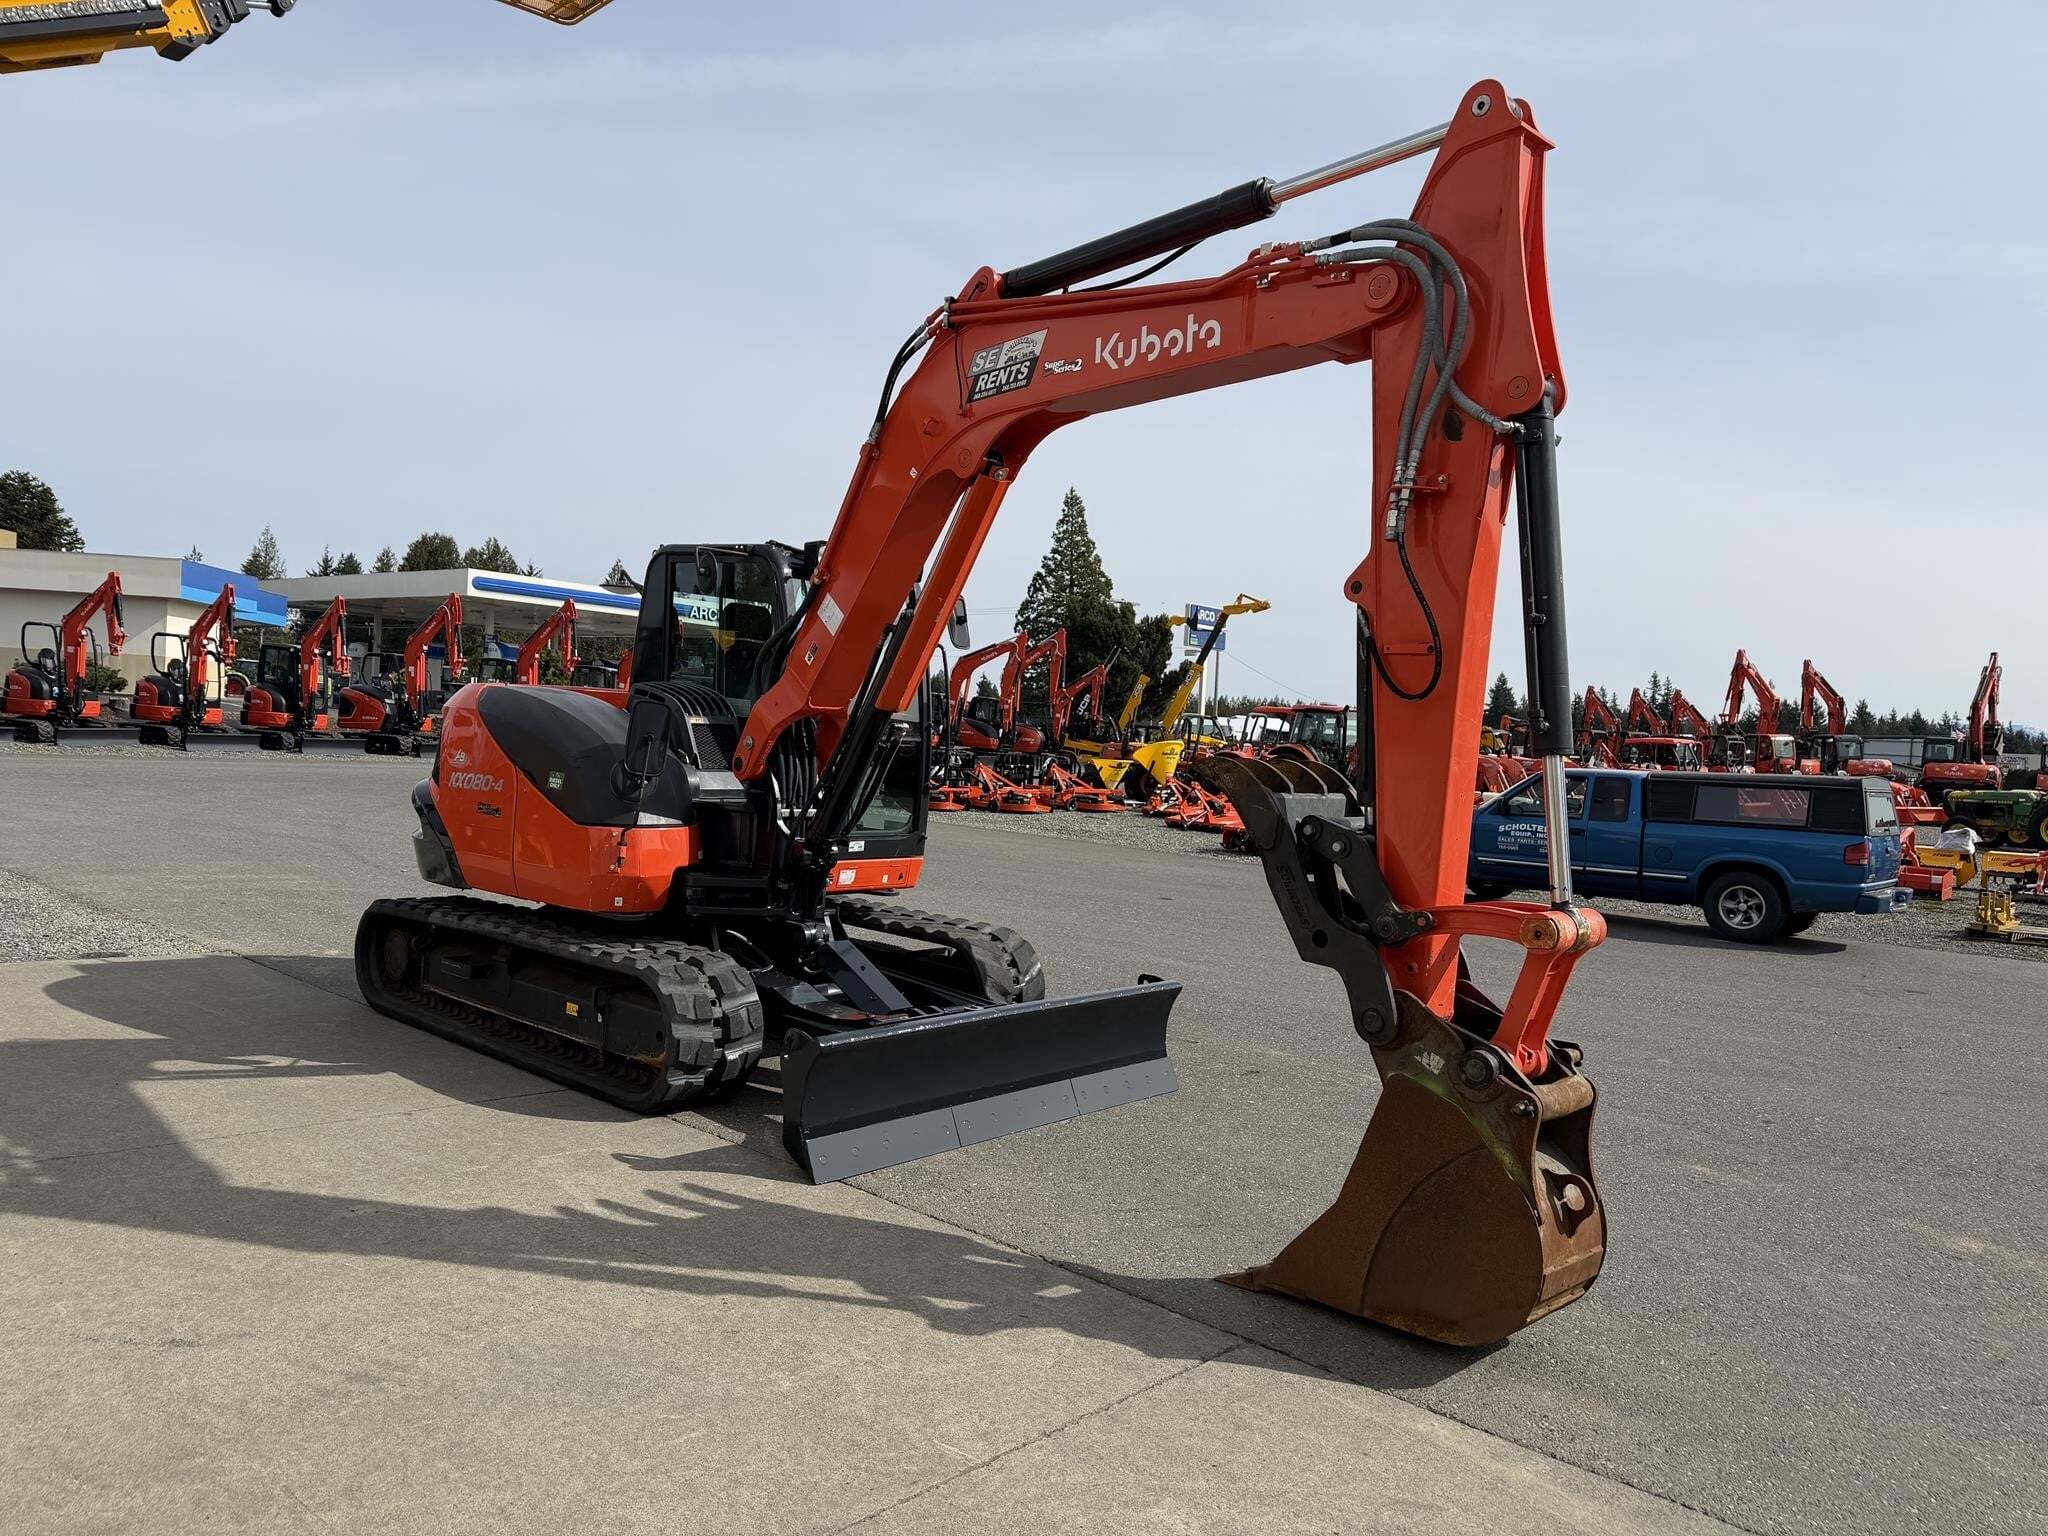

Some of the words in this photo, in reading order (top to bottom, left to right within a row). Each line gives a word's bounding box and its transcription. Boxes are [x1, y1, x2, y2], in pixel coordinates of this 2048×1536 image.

[1094, 313, 1221, 370] Kubota
[972, 347, 1000, 372] SE
[975, 360, 1031, 393] RENTS
[690, 606, 719, 621] ARC
[1077, 693, 1092, 716] JCB
[448, 771, 505, 793] KX080-4
